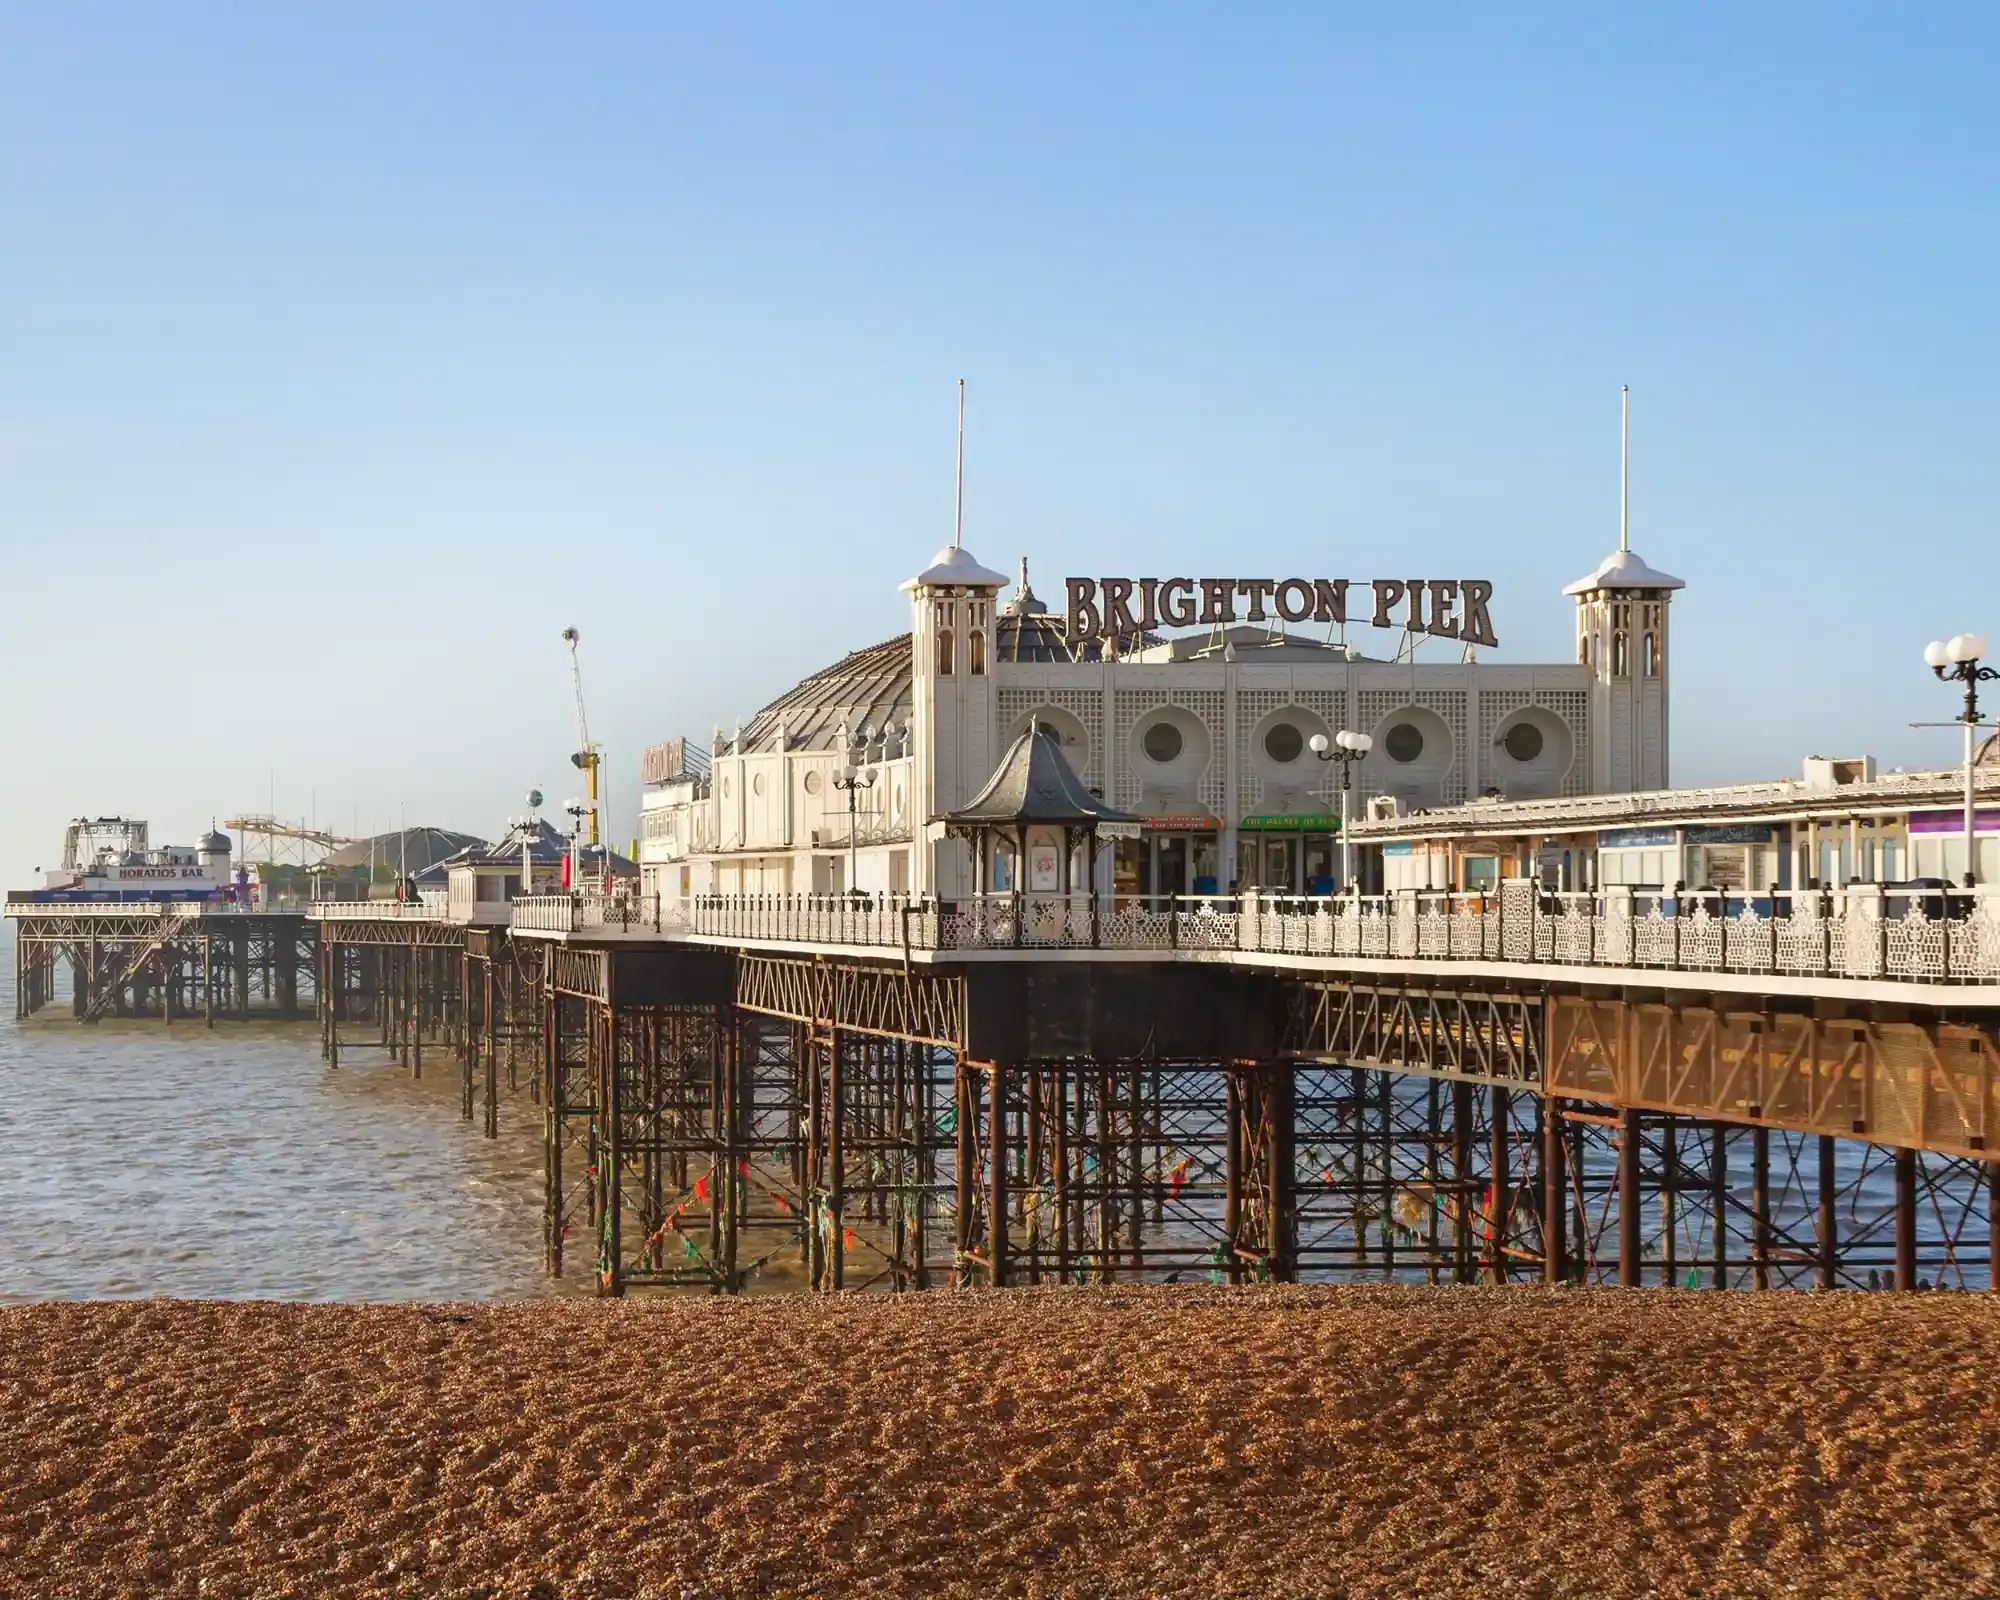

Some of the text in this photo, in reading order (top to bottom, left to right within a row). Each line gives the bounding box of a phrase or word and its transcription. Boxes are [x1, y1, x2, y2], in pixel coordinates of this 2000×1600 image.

[1065, 577, 1498, 648] BRIGHTON PIER
[119, 868, 204, 878] HORATIOS BAR
